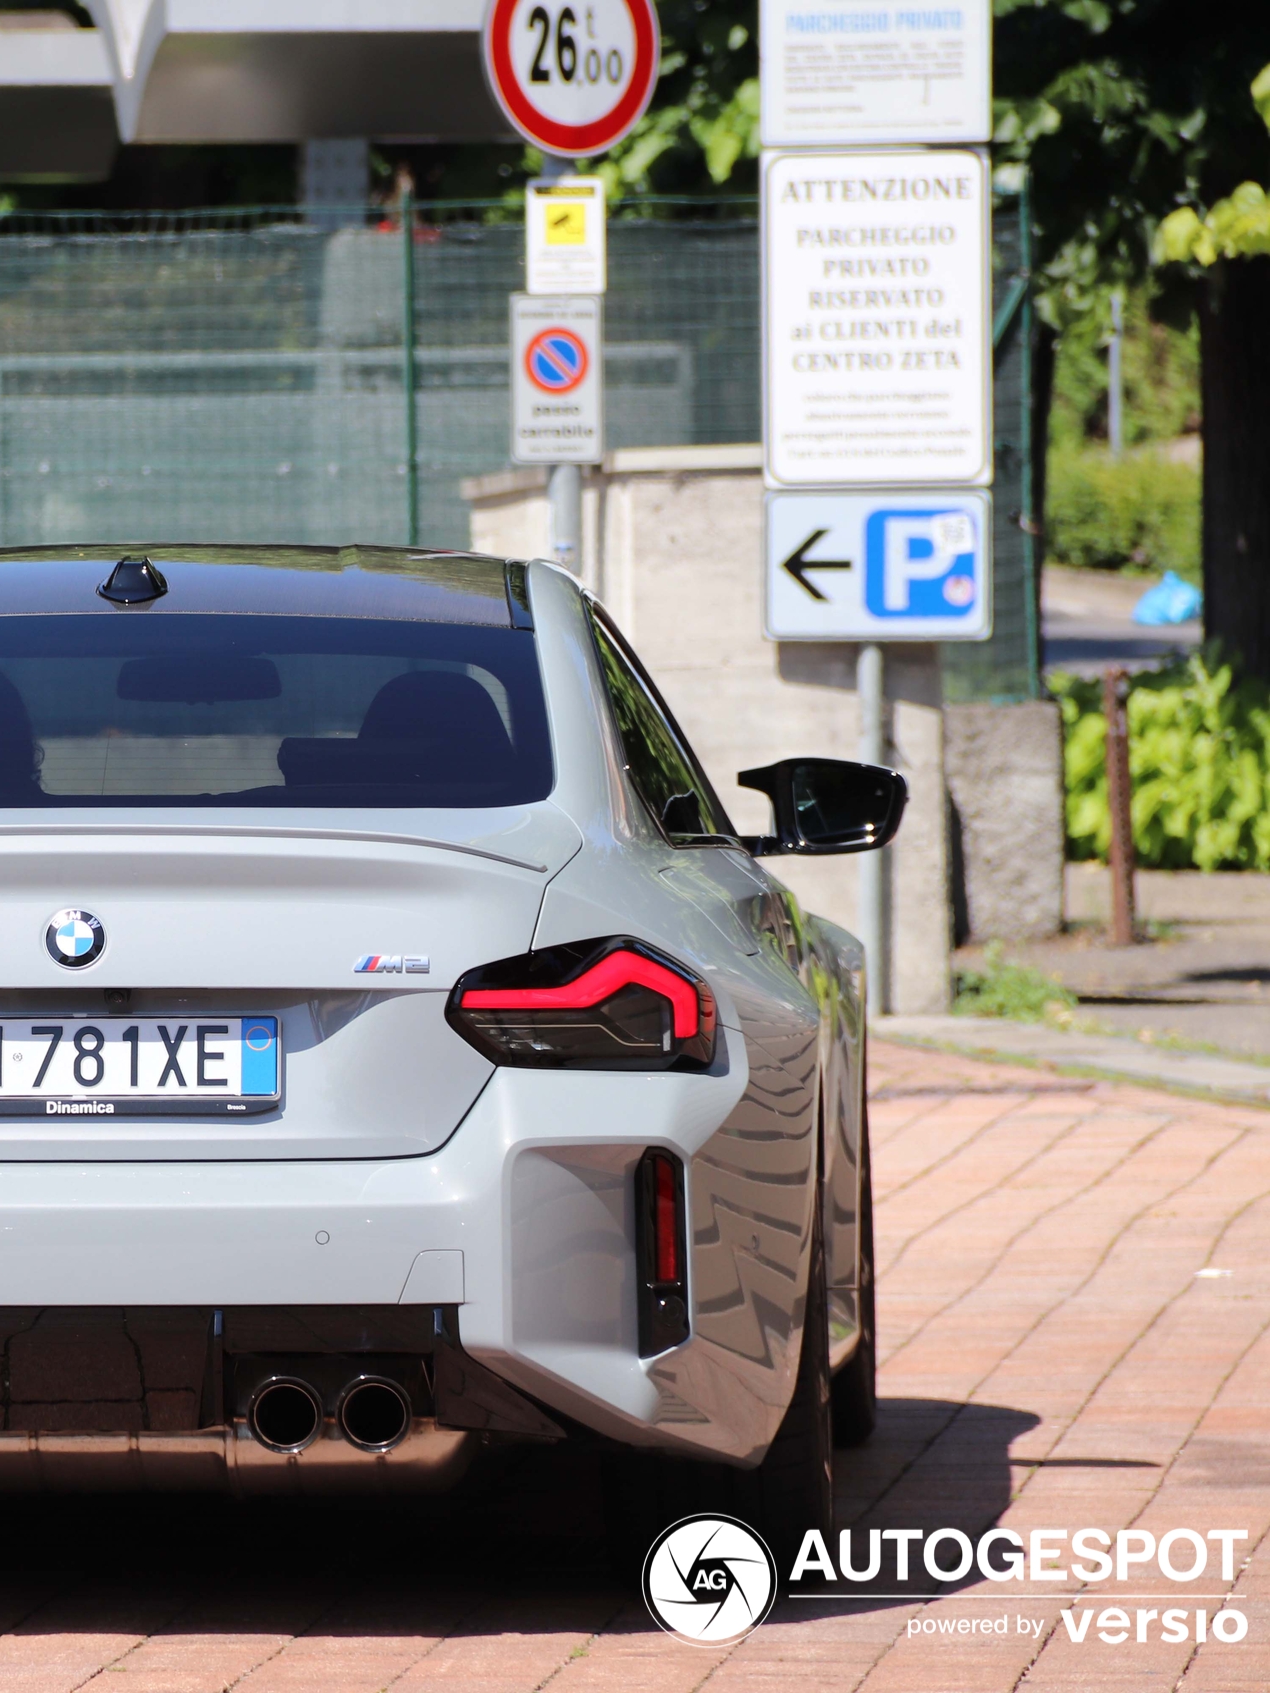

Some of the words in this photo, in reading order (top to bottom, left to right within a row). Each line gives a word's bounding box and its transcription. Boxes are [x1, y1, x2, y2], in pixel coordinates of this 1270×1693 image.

[785, 11, 889, 33] PARCHEGGIO
[896, 9, 963, 30] PRIVATO
[780, 176, 971, 203] ATTENZIONE
[795, 225, 957, 249] PARCHEGGIO
[822, 256, 930, 279] PRIVATO
[807, 287, 945, 311] RISERVATO
[790, 320, 812, 341] ai
[819, 318, 917, 342] CLIENTI
[924, 317, 962, 340] del
[792, 350, 893, 373] CENTRO
[900, 348, 962, 371] ZETA
[532, 403, 581, 420] passo
[519, 424, 594, 439] carrabile
[884, 516, 957, 612] P
[52, 910, 101, 930] BMW
[31, 1025, 229, 1088] 781XE
[45, 1100, 115, 1115] Dinamica
